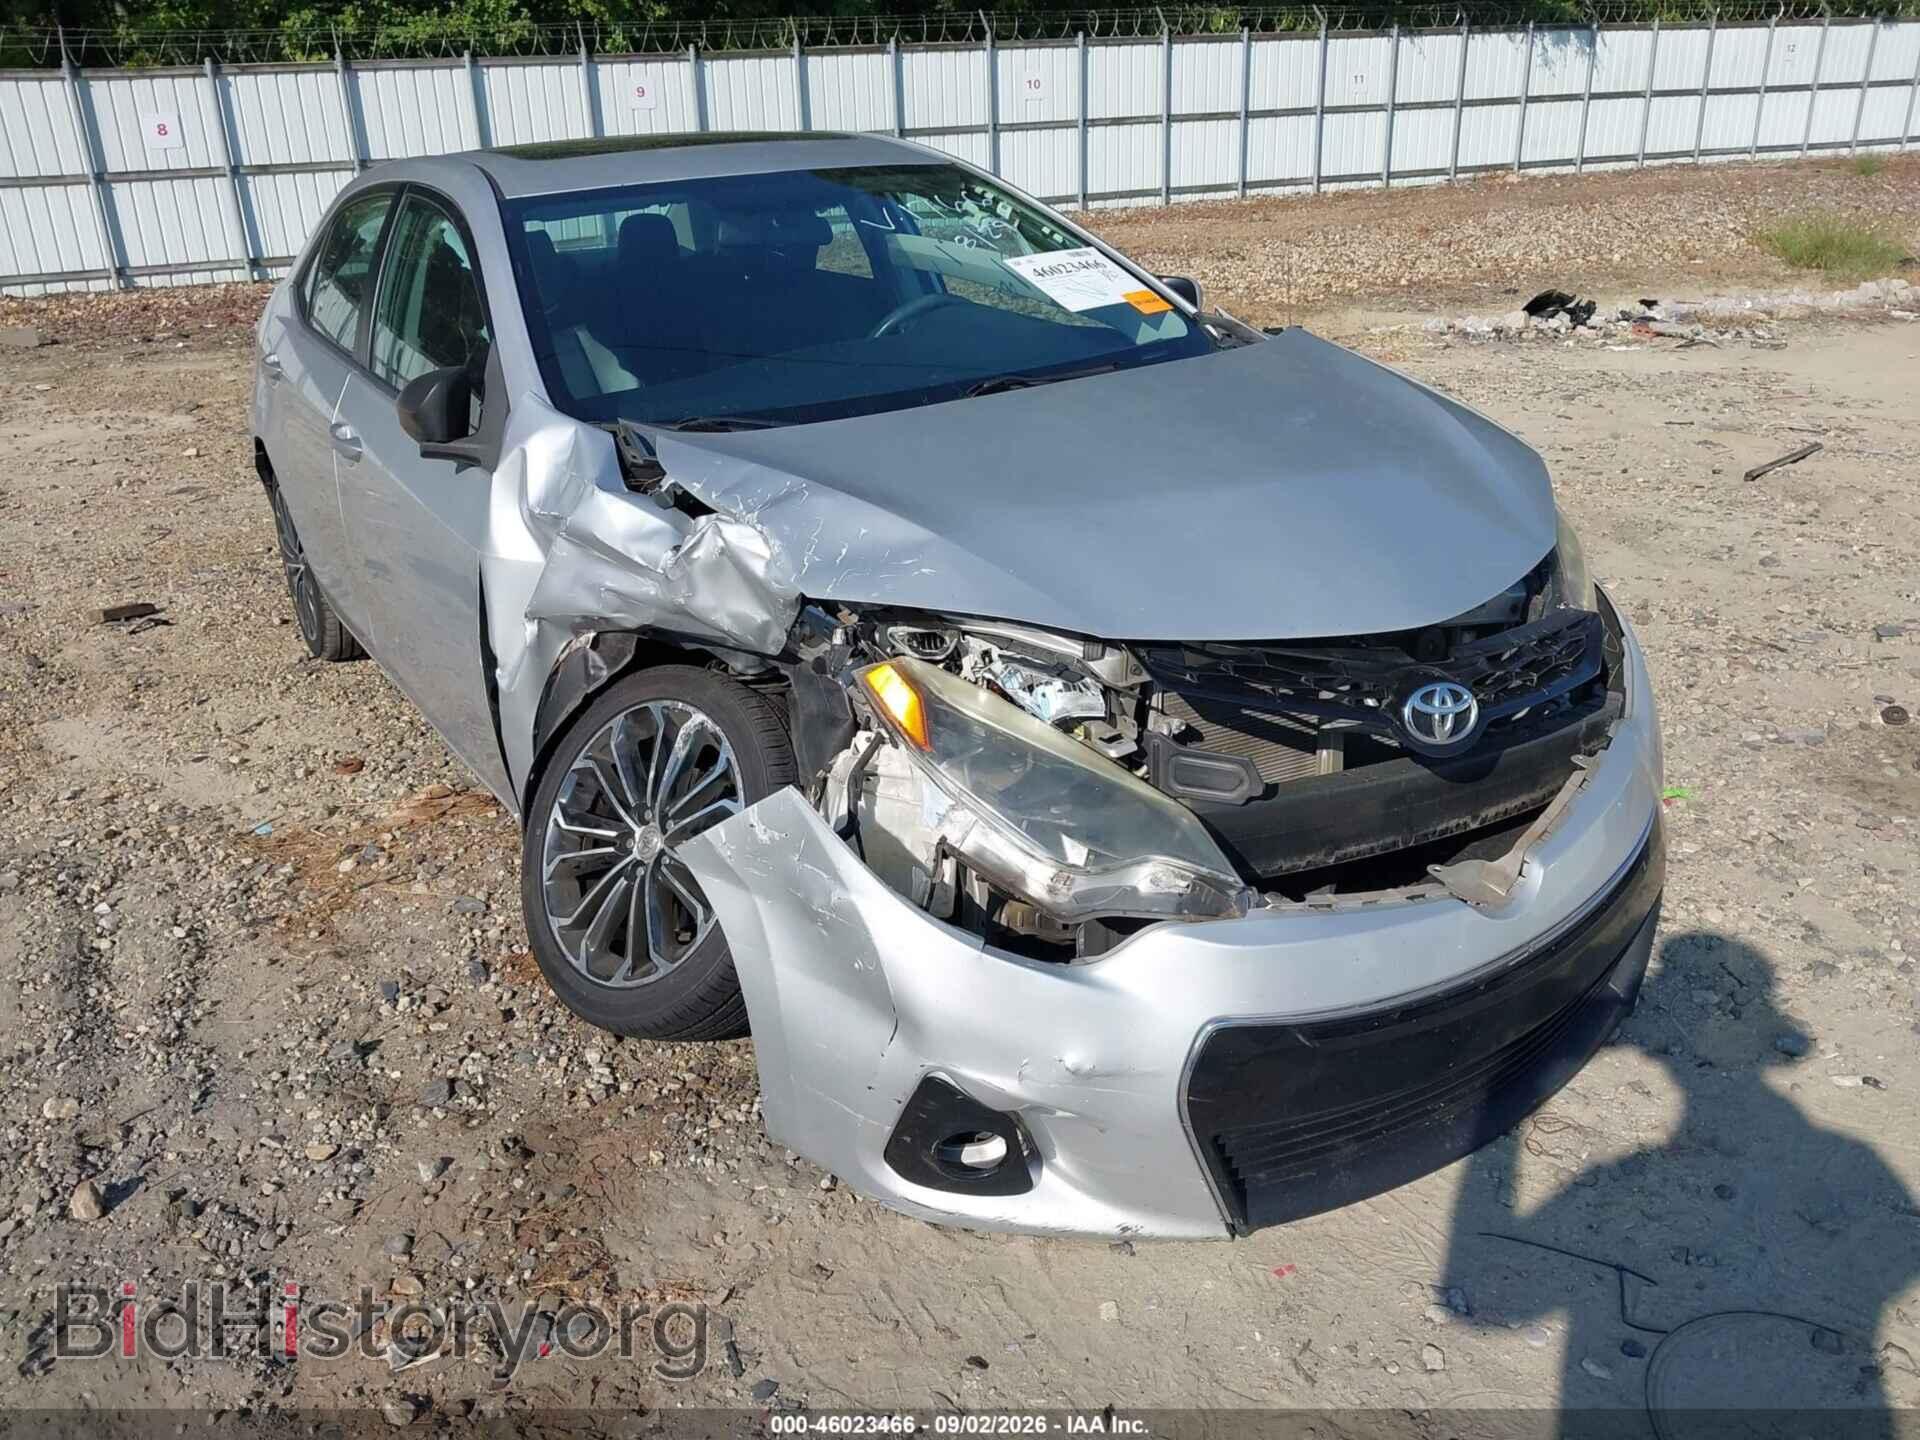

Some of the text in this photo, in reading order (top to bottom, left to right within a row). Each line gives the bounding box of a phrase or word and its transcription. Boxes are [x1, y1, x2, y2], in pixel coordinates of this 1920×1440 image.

[1025, 79, 1041, 90] 10
[1354, 74, 1364, 84] 11
[636, 86, 645, 98] 9
[157, 123, 168, 136] 8
[1031, 259, 1108, 279] 46023466
